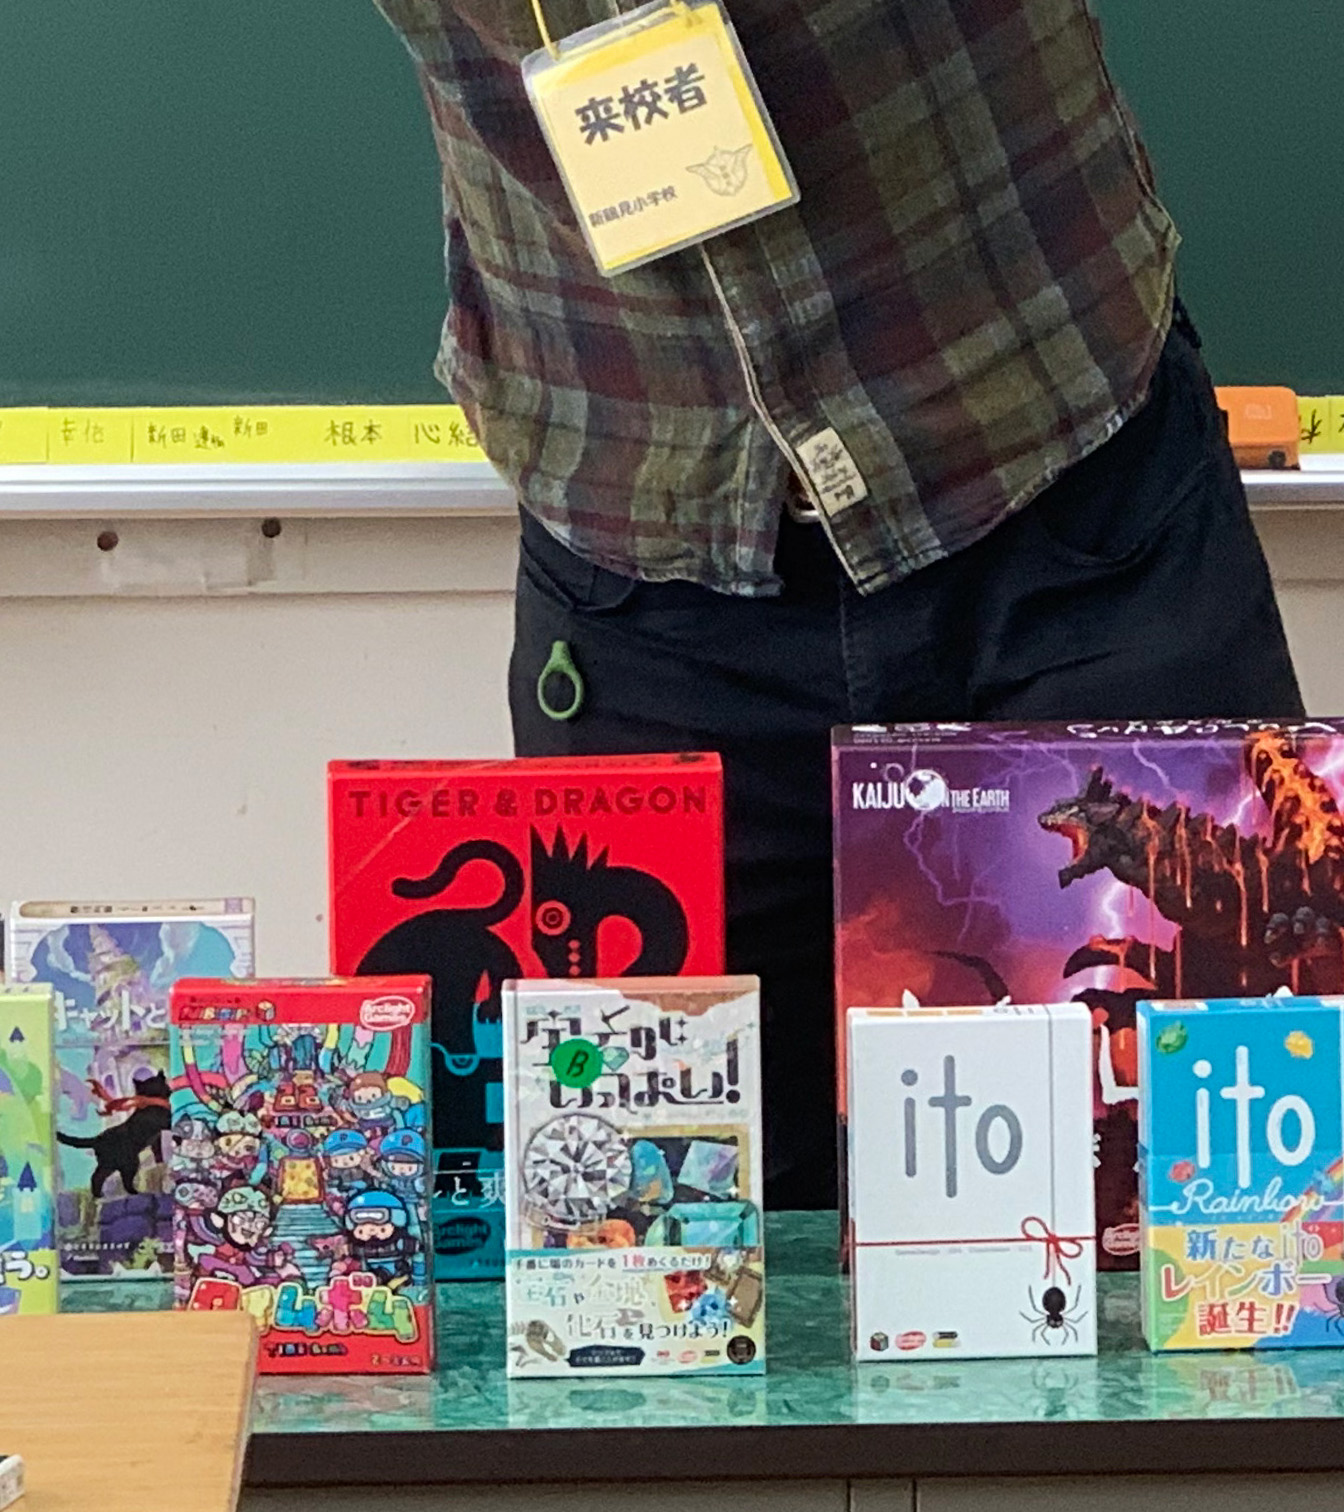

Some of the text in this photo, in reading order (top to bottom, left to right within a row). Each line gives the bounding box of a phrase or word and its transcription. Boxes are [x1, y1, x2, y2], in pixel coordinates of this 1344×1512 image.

[575, 63, 707, 145] 来校者
[323, 419, 384, 448] 根本
[348, 785, 707, 819] TIGER & DRAGON
[852, 782, 905, 810] KAIJU
[899, 1054, 1023, 1199] ito
[1192, 1044, 1316, 1189] ito
[1171, 1176, 1326, 1215] Rainbow
[1163, 1262, 1332, 1302] レインボー
